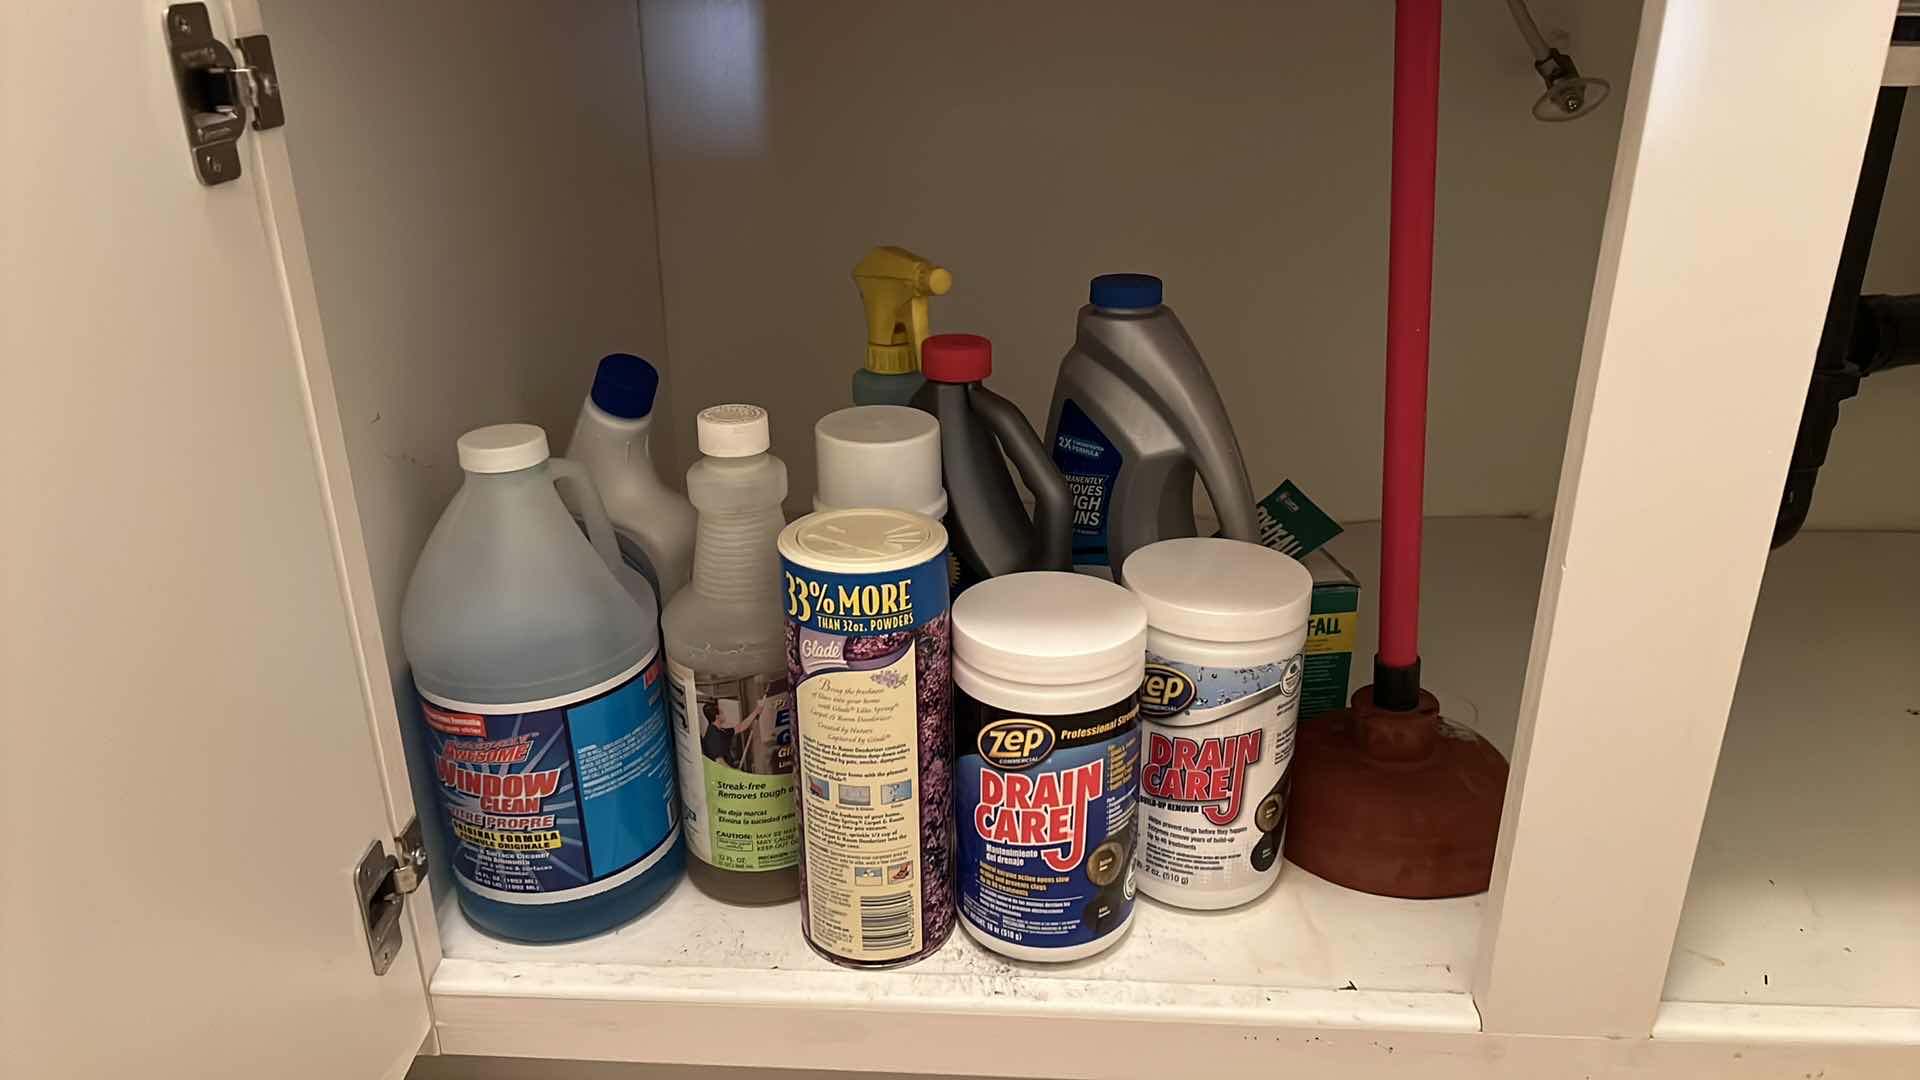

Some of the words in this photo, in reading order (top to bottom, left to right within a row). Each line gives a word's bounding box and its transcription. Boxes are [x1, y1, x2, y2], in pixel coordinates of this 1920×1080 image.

[1058, 436, 1072, 449] 2X
[785, 571, 835, 622] 33%
[838, 579, 913, 617] MORE
[817, 616, 841, 631] THAN
[843, 619, 868, 632] 32oz.
[870, 612, 914, 631] POWDERS
[801, 639, 841, 659] Glade
[1061, 717, 1118, 741] Professional
[434, 757, 561, 798] WINDOW
[717, 780, 767, 791] Streak-free
[1142, 763, 1232, 802] CARE
[718, 789, 758, 800] Removes
[760, 786, 787, 799] tough
[479, 796, 541, 814] CLEAN
[1167, 803, 1200, 814] REMOVER
[485, 814, 556, 830] PROPRE
[974, 803, 1074, 847] CARE
[497, 841, 551, 851] ORIGINALE
[499, 831, 560, 843] FORMULA
